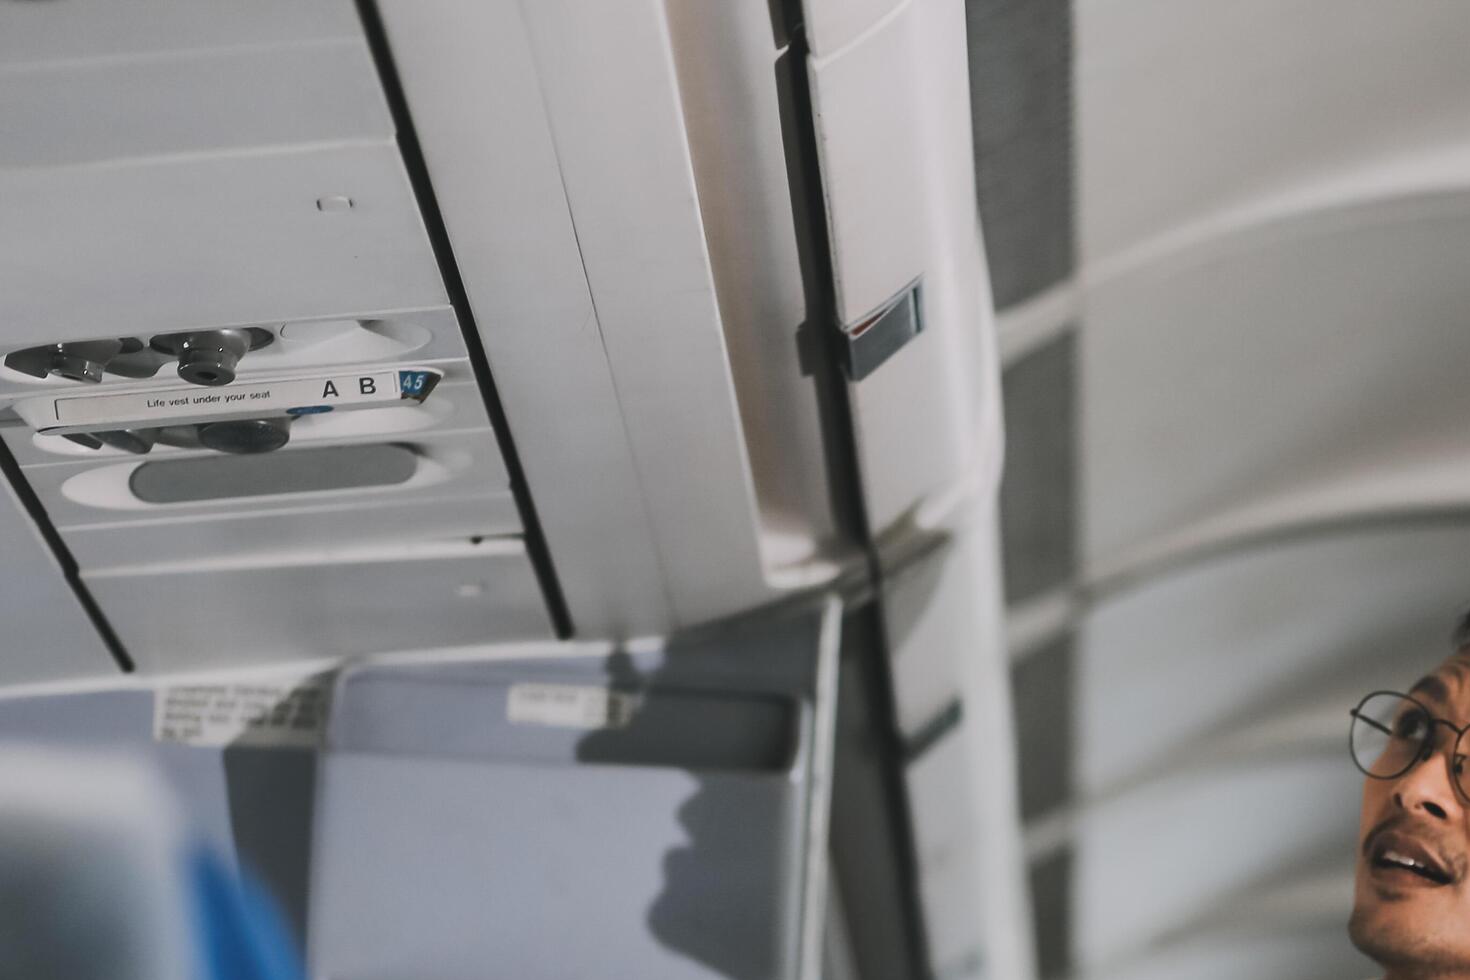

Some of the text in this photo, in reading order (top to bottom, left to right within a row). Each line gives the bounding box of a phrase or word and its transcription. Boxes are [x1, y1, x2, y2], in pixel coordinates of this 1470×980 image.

[322, 377, 377, 398] A B
[403, 374, 425, 390] 45
[147, 390, 271, 408] Life vest under your seat
